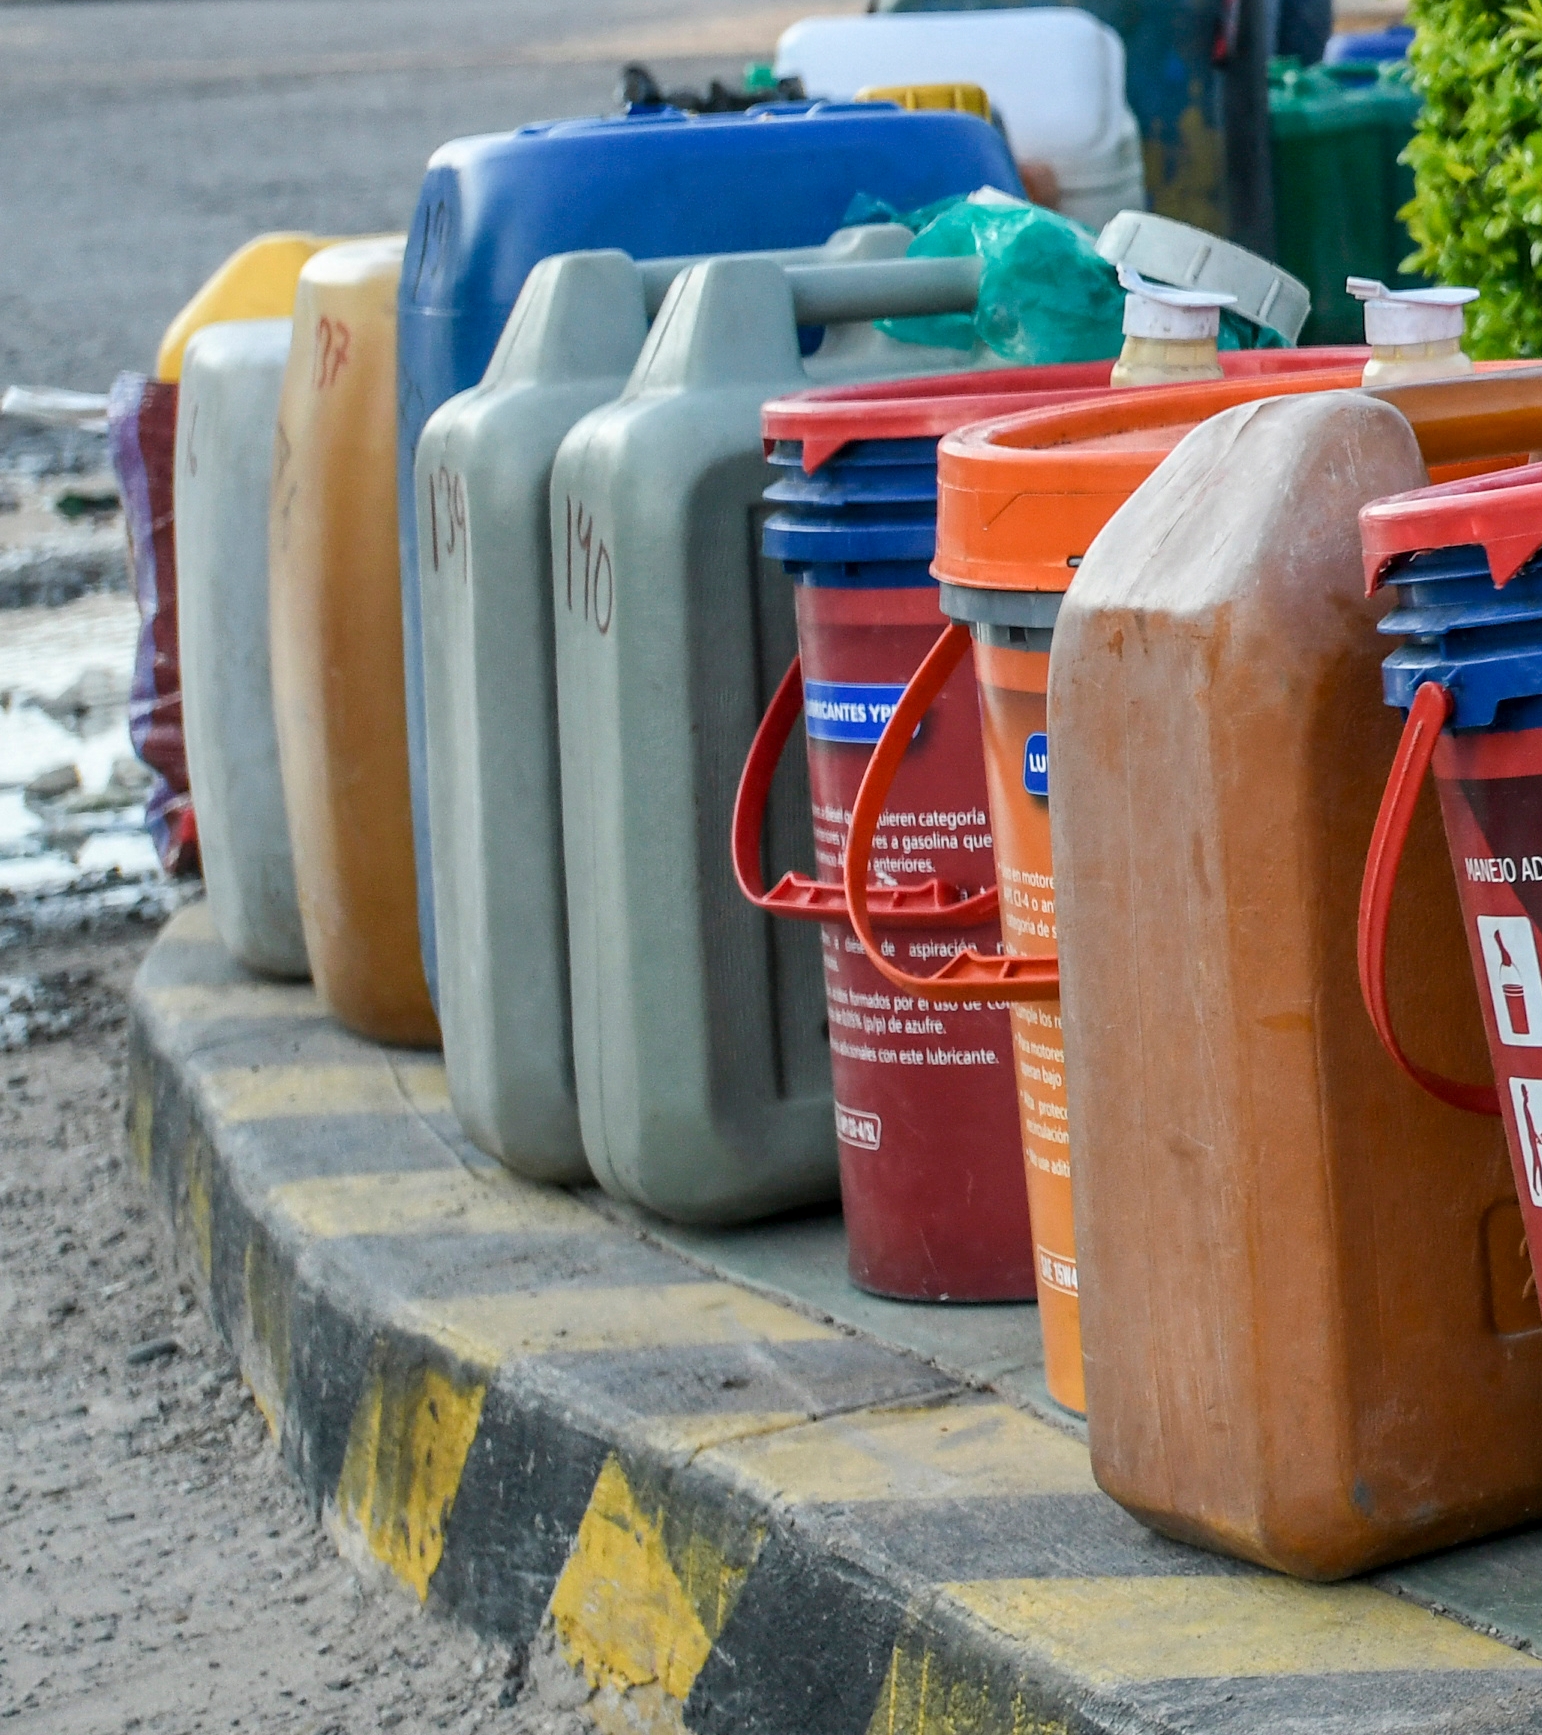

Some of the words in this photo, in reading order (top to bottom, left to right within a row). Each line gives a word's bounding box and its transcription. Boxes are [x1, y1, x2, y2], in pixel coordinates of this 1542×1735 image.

[566, 493, 613, 638] 140
[1029, 753, 1048, 773] LU
[918, 806, 986, 831] categoría
[902, 831, 959, 854] gasolina
[963, 833, 993, 853] que
[873, 855, 937, 873] anteriores.
[1465, 857, 1517, 883] MANEJO
[1022, 870, 1055, 889] motore
[880, 938, 896, 958] de
[893, 995, 914, 1014] por
[887, 1014, 903, 1034] de
[905, 1015, 947, 1035] azufre.
[878, 1048, 897, 1064] con
[899, 1049, 924, 1066] este
[926, 1046, 1000, 1066] lubricante.
[1053, 1261, 1079, 1291] 15W4
